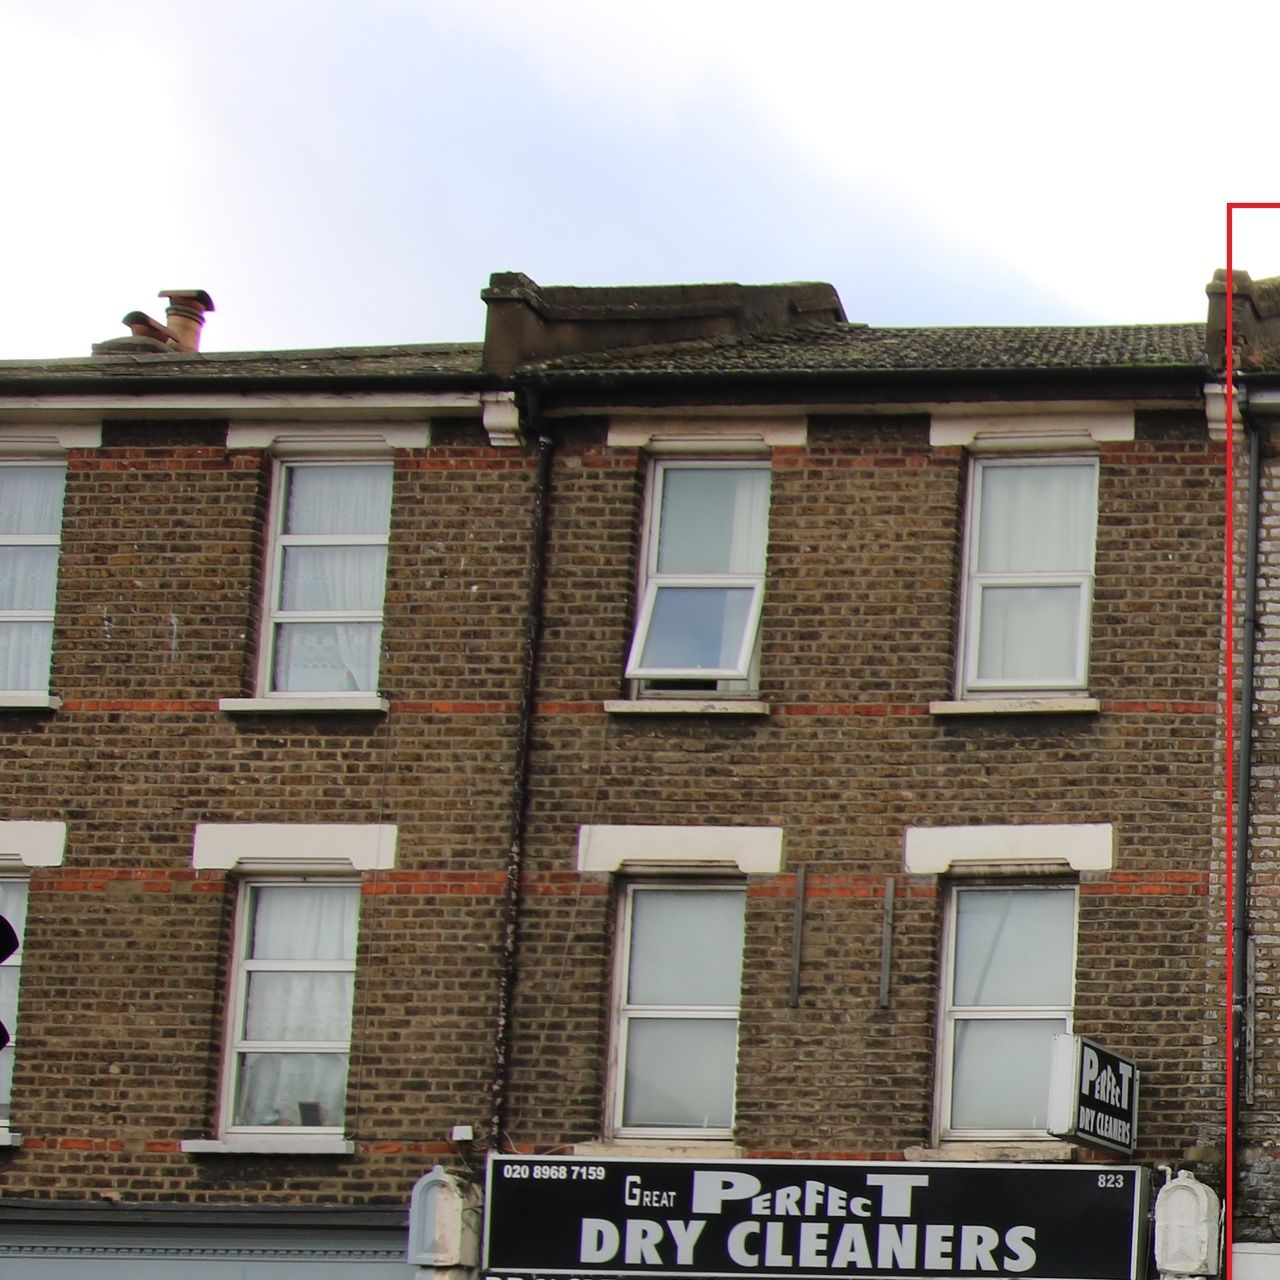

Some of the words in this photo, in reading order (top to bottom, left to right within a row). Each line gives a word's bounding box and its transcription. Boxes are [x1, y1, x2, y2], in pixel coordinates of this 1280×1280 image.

[1079, 1105, 1096, 1132] DRY
[1096, 1113, 1131, 1145] CLEANERS
[503, 1164, 529, 1178] 020
[533, 1165, 567, 1180] 8968
[571, 1166, 605, 1180] 7159
[1098, 1174, 1124, 1188] 823
[580, 1217, 707, 1266] DRY
[727, 1220, 1037, 1272] CLEANERS
